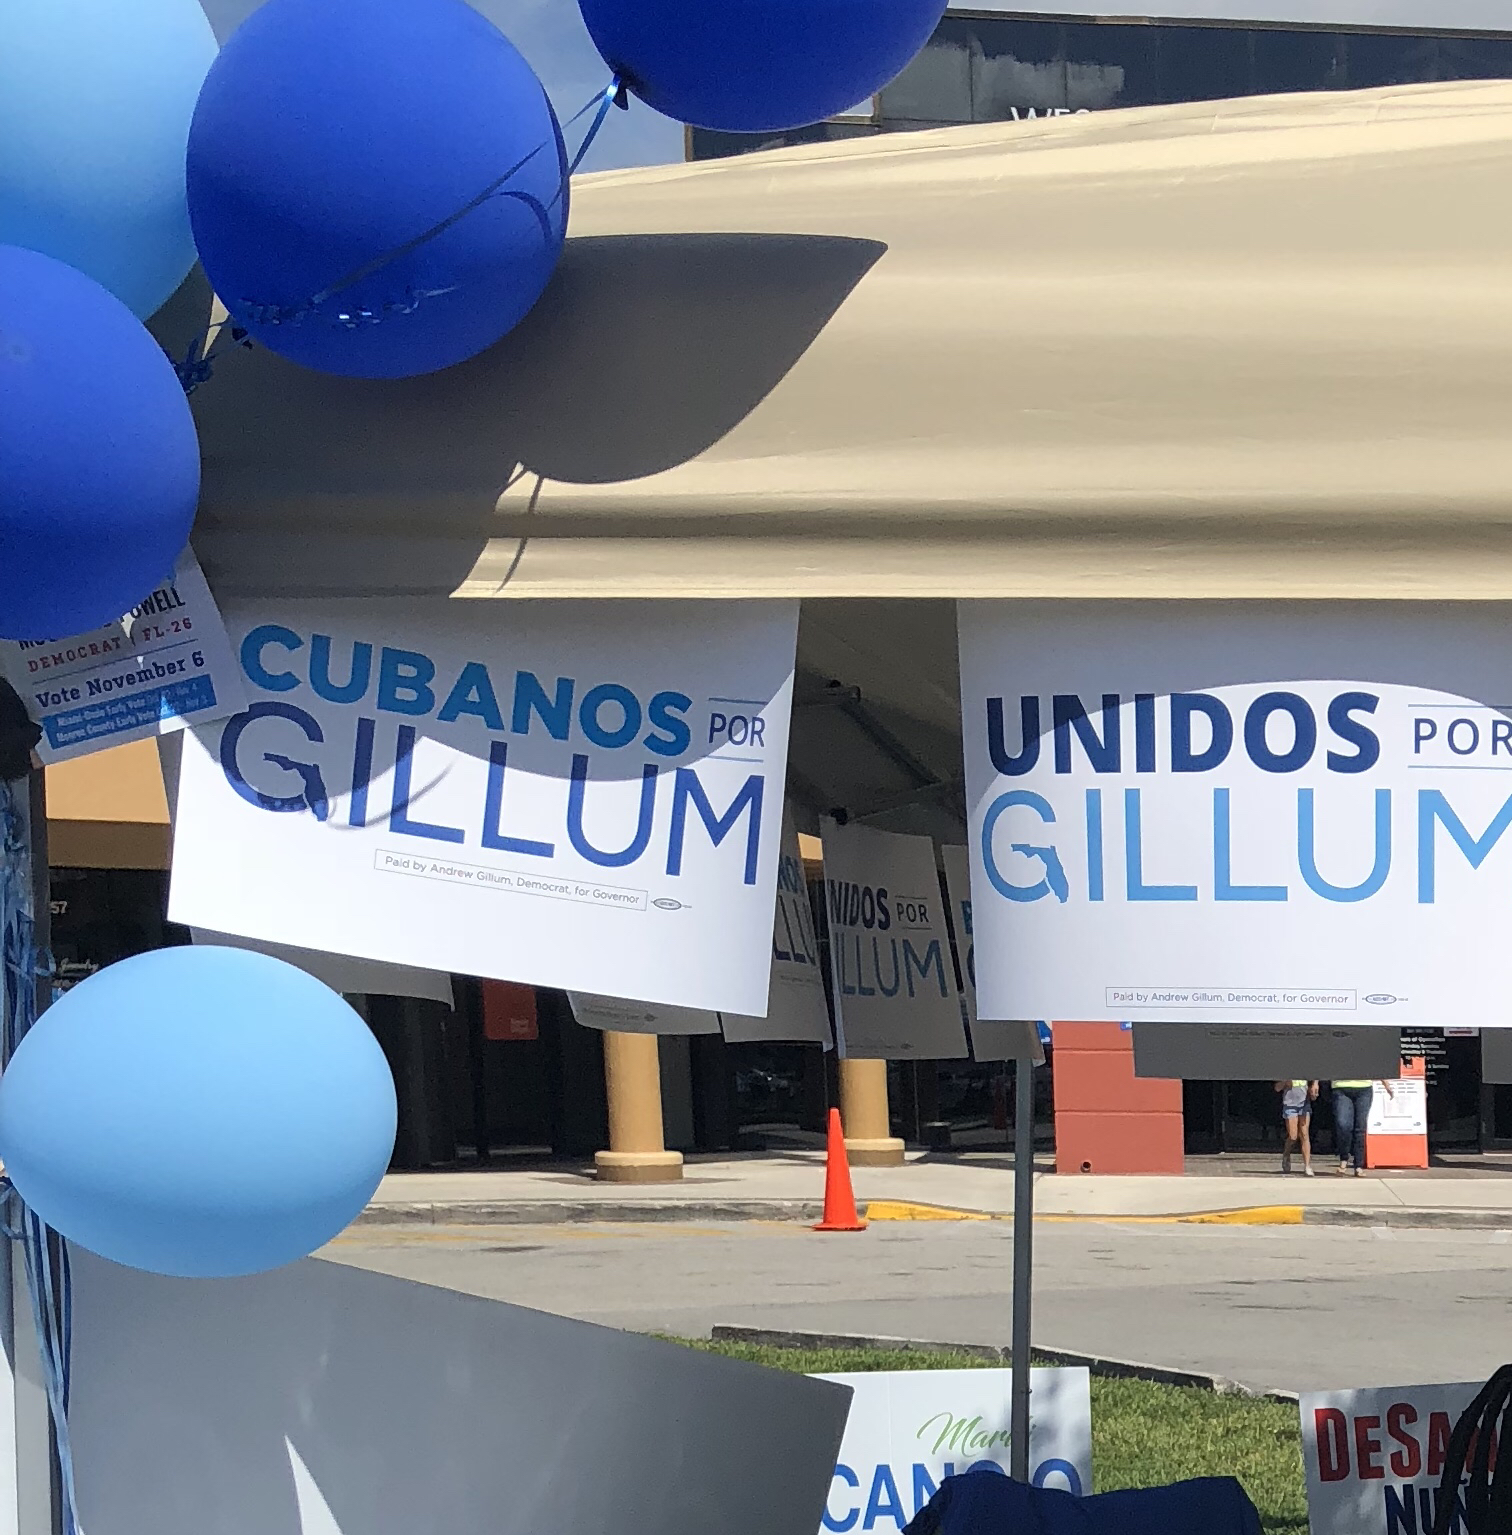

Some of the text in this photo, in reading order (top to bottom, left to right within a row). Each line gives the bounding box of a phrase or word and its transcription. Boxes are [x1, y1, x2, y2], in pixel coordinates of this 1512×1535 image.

[28, 636, 121, 673] DEMOCRAT
[142, 617, 192, 642] FL-26
[36, 686, 81, 708] Vote
[86, 656, 186, 697] November
[192, 650, 204, 667] 6
[240, 625, 767, 757] CUBANOS POR
[986, 691, 1381, 777] UNIDOS
[219, 701, 765, 886] GILLUM
[385, 855, 410, 870] Paid
[413, 860, 427, 873] by
[430, 863, 473, 880] Andrew
[477, 870, 514, 887] Gillum,
[516, 877, 571, 896] Democrat,
[575, 886, 590, 897] for
[592, 888, 640, 904] Governor
[896, 902, 929, 923] POR
[1113, 992, 1349, 1004] Paid by Andrew Gillum, Democrat, for Governor
